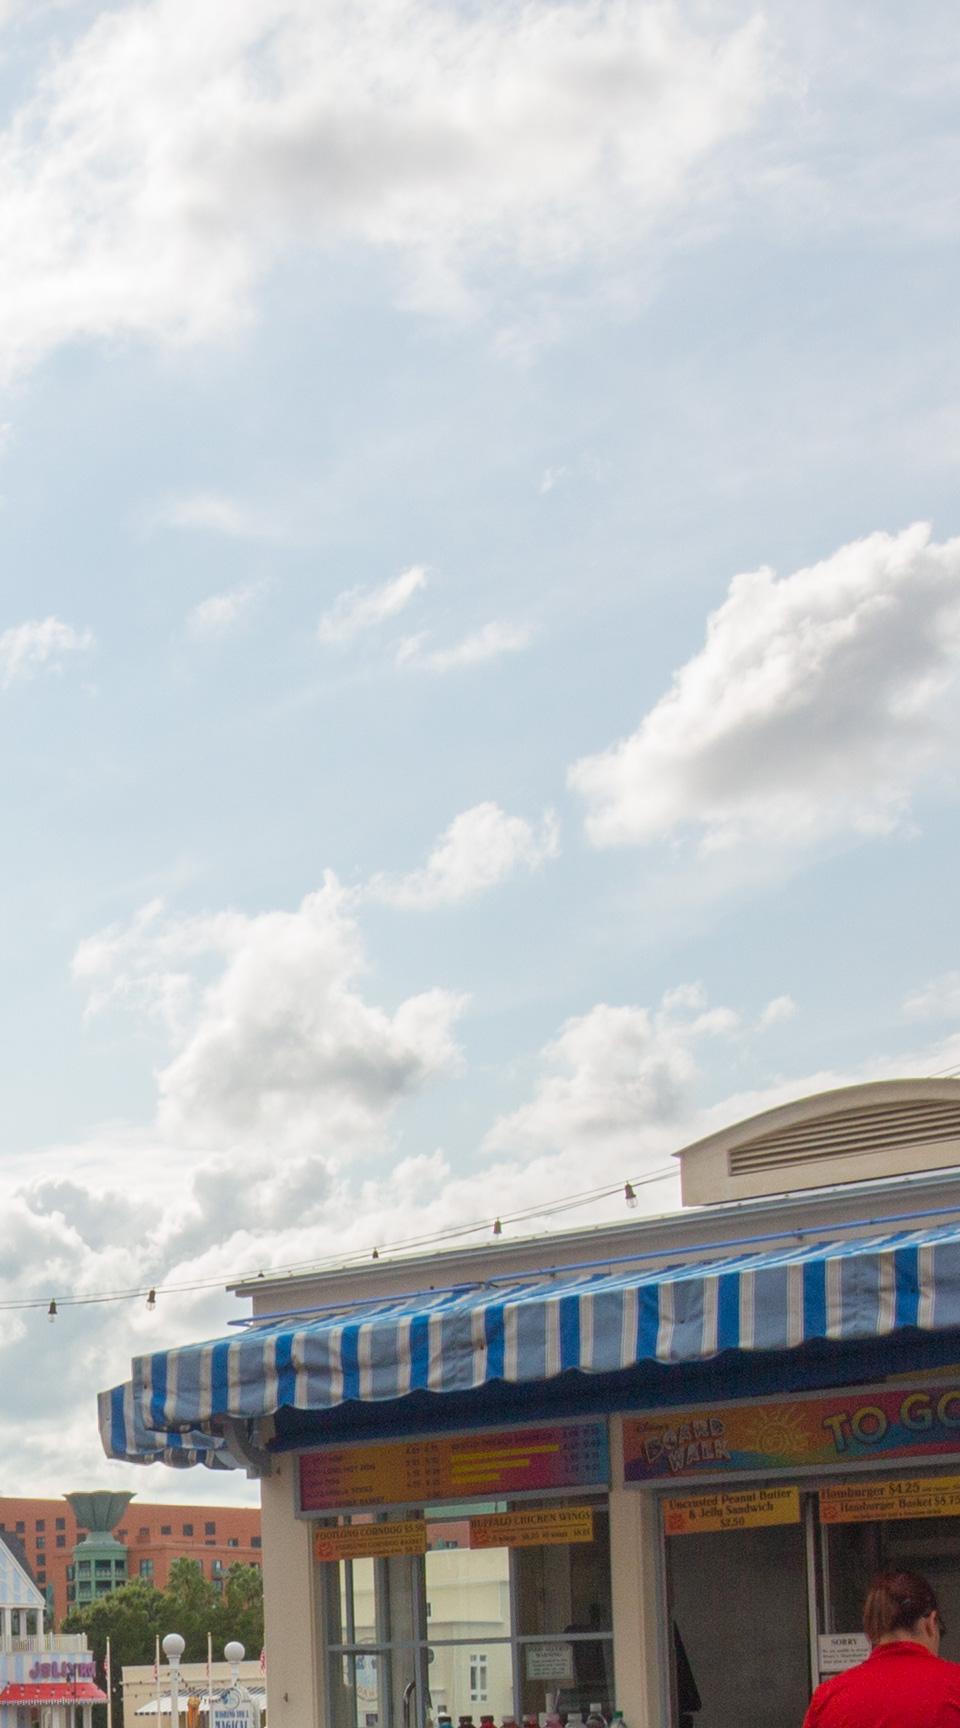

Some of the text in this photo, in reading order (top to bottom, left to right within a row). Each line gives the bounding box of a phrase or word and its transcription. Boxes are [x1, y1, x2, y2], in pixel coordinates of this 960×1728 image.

[823, 1406, 887, 1452] TO
[643, 1417, 726, 1465] BOARD
[668, 1439, 731, 1473] WALK
[669, 1489, 793, 1510] Uncrusted Peanut Butter
[821, 1487, 885, 1501] Hamburger
[688, 1501, 774, 1519] & Jelly Sandwich
[841, 1501, 895, 1513] Hamburger
[514, 1513, 556, 1526] CHICKEN
[558, 1511, 591, 1521] WINGS
[360, 1526, 402, 1537] CORNDOG
[831, 1638, 857, 1646] SORRY
